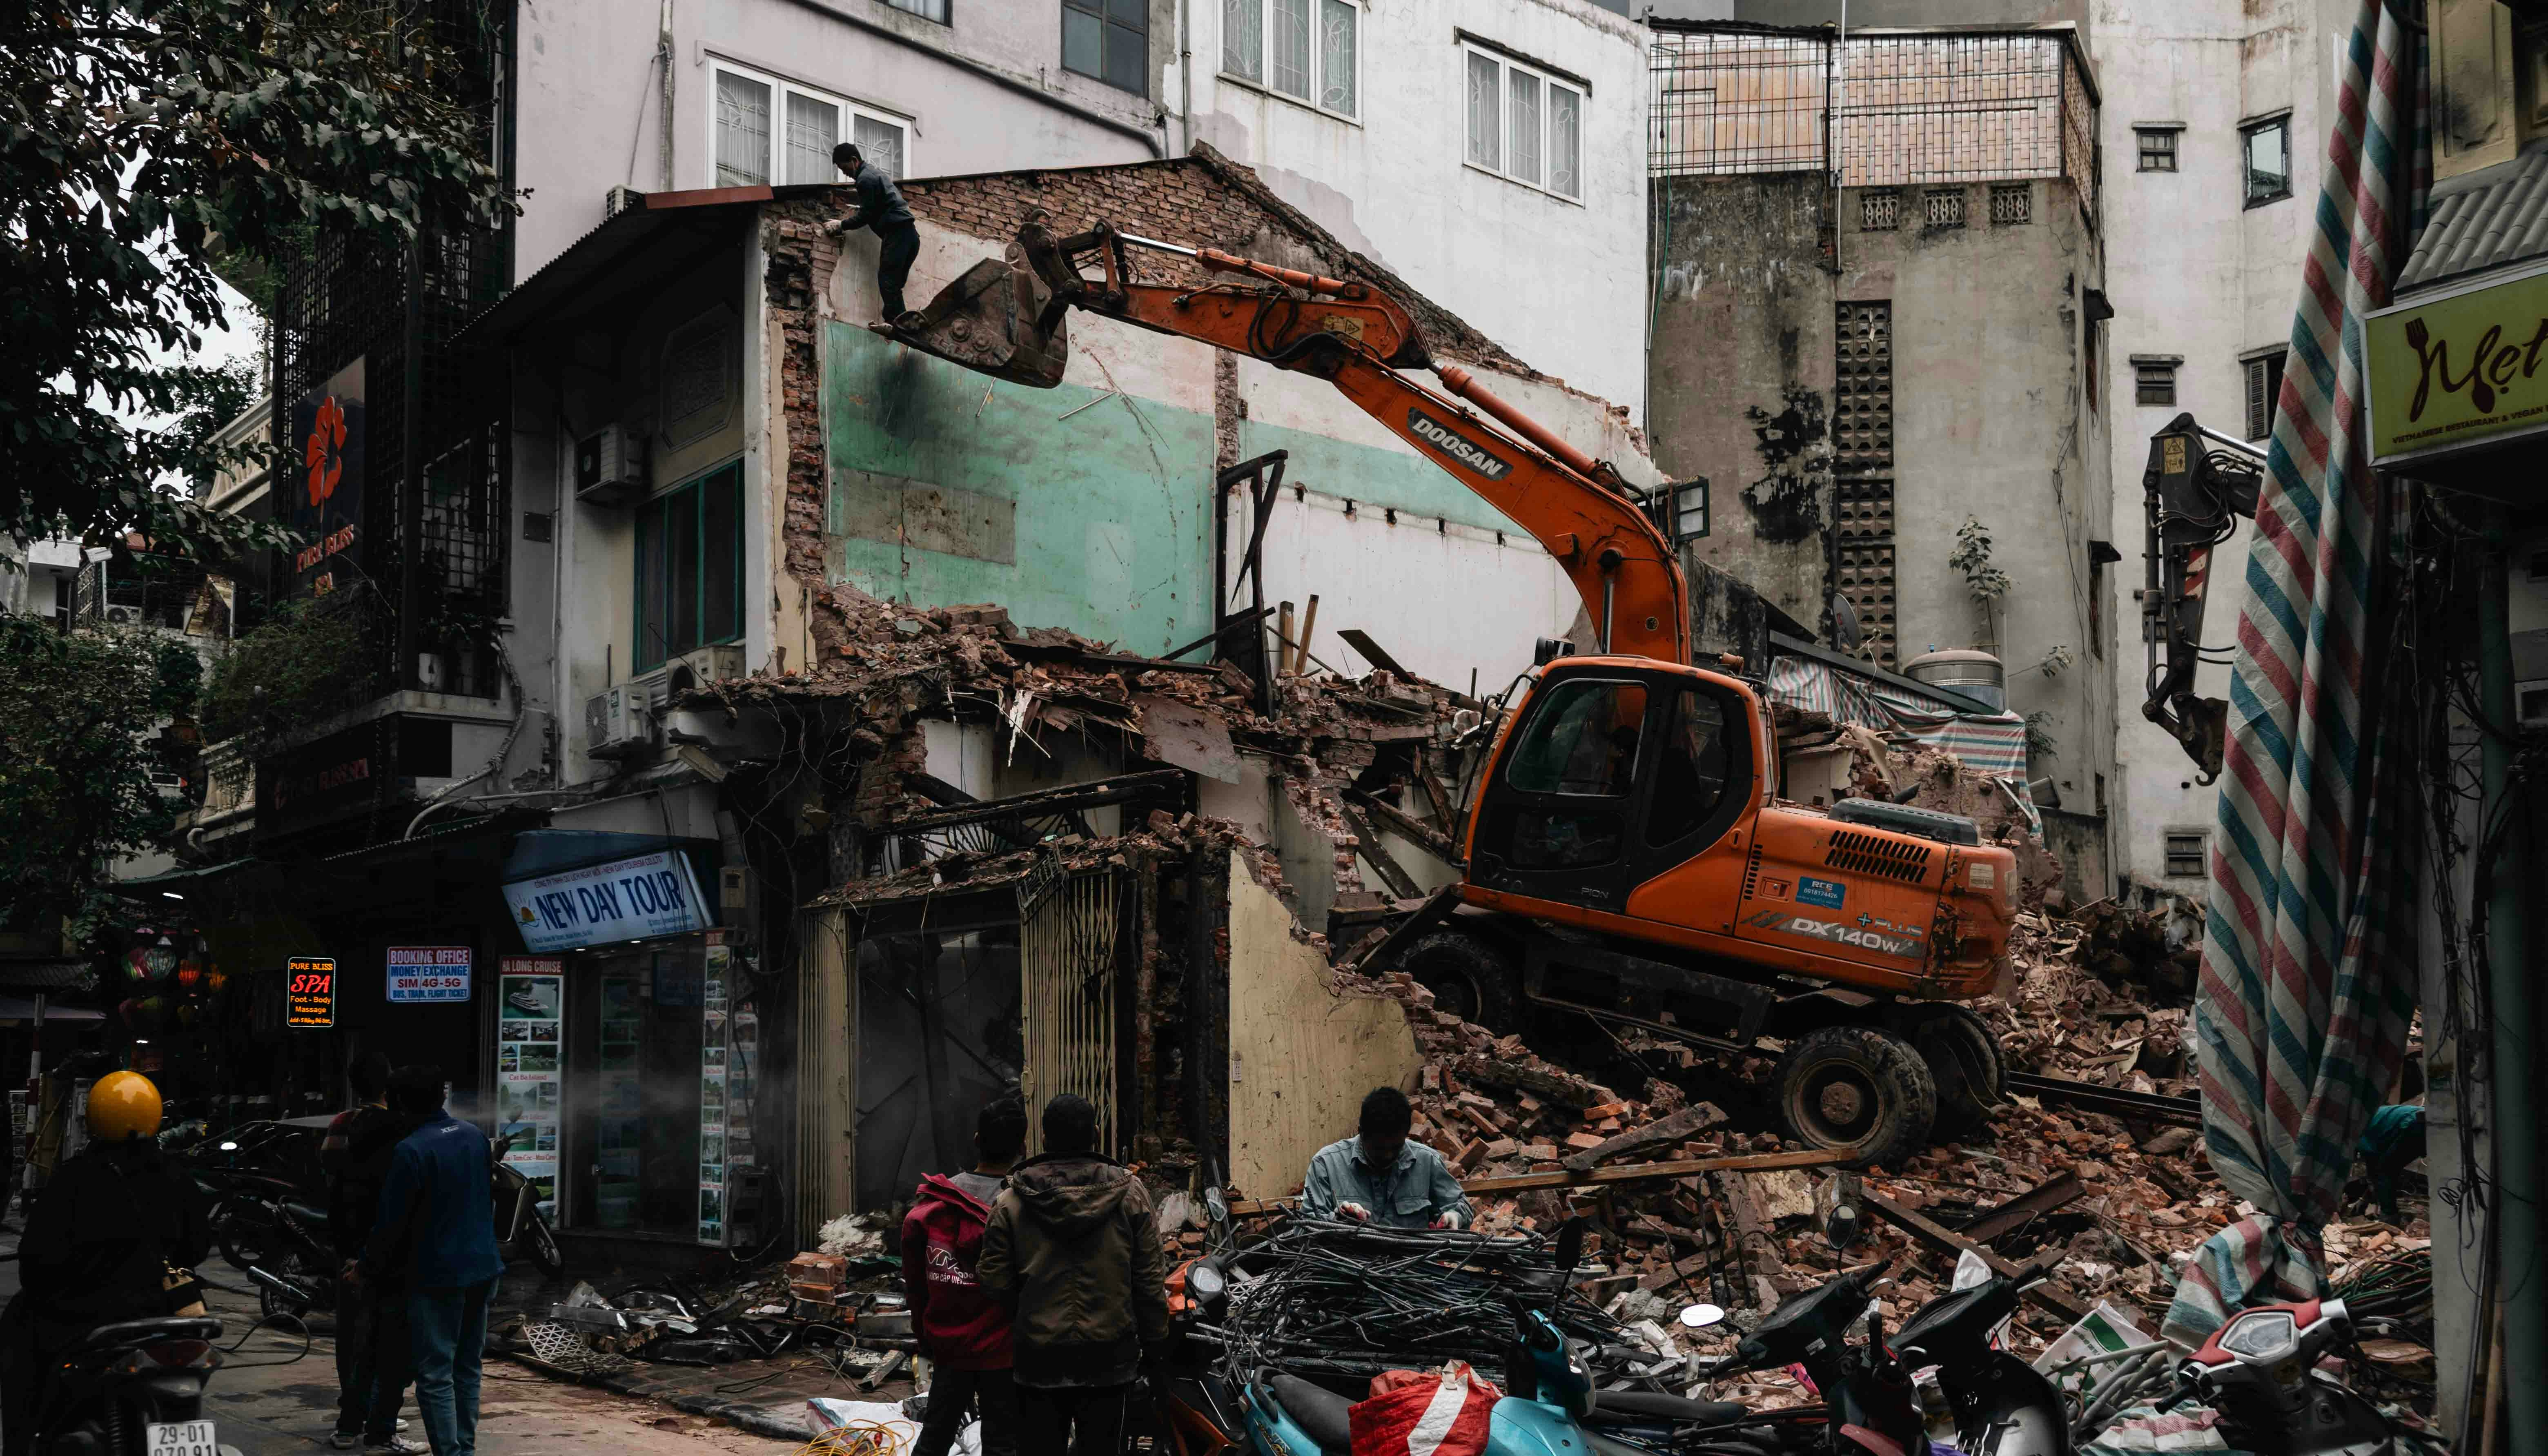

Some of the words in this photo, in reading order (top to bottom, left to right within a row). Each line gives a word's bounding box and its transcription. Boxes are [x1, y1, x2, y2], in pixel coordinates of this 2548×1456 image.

[2446, 417, 2499, 432] RESTAURANT
[2511, 407, 2544, 419] VEGAN
[1412, 418, 1503, 476] DOOSAN
[535, 890, 580, 931] NEW
[578, 882, 623, 924] DAY
[620, 870, 686, 915] TOUR
[391, 950, 433, 964] BOOKING
[436, 950, 468, 964] OFFICE
[290, 962, 310, 970] PURE
[391, 966, 421, 977] MONEY
[423, 965, 468, 976] EXCHANGE
[512, 960, 533, 972] LONG
[534, 960, 562, 973] CRUISE
[290, 973, 331, 993] SPA
[398, 979, 418, 988] SIM
[449, 989, 468, 997] TICKET
[313, 996, 332, 1004] Body
[295, 1006, 327, 1015] Massage
